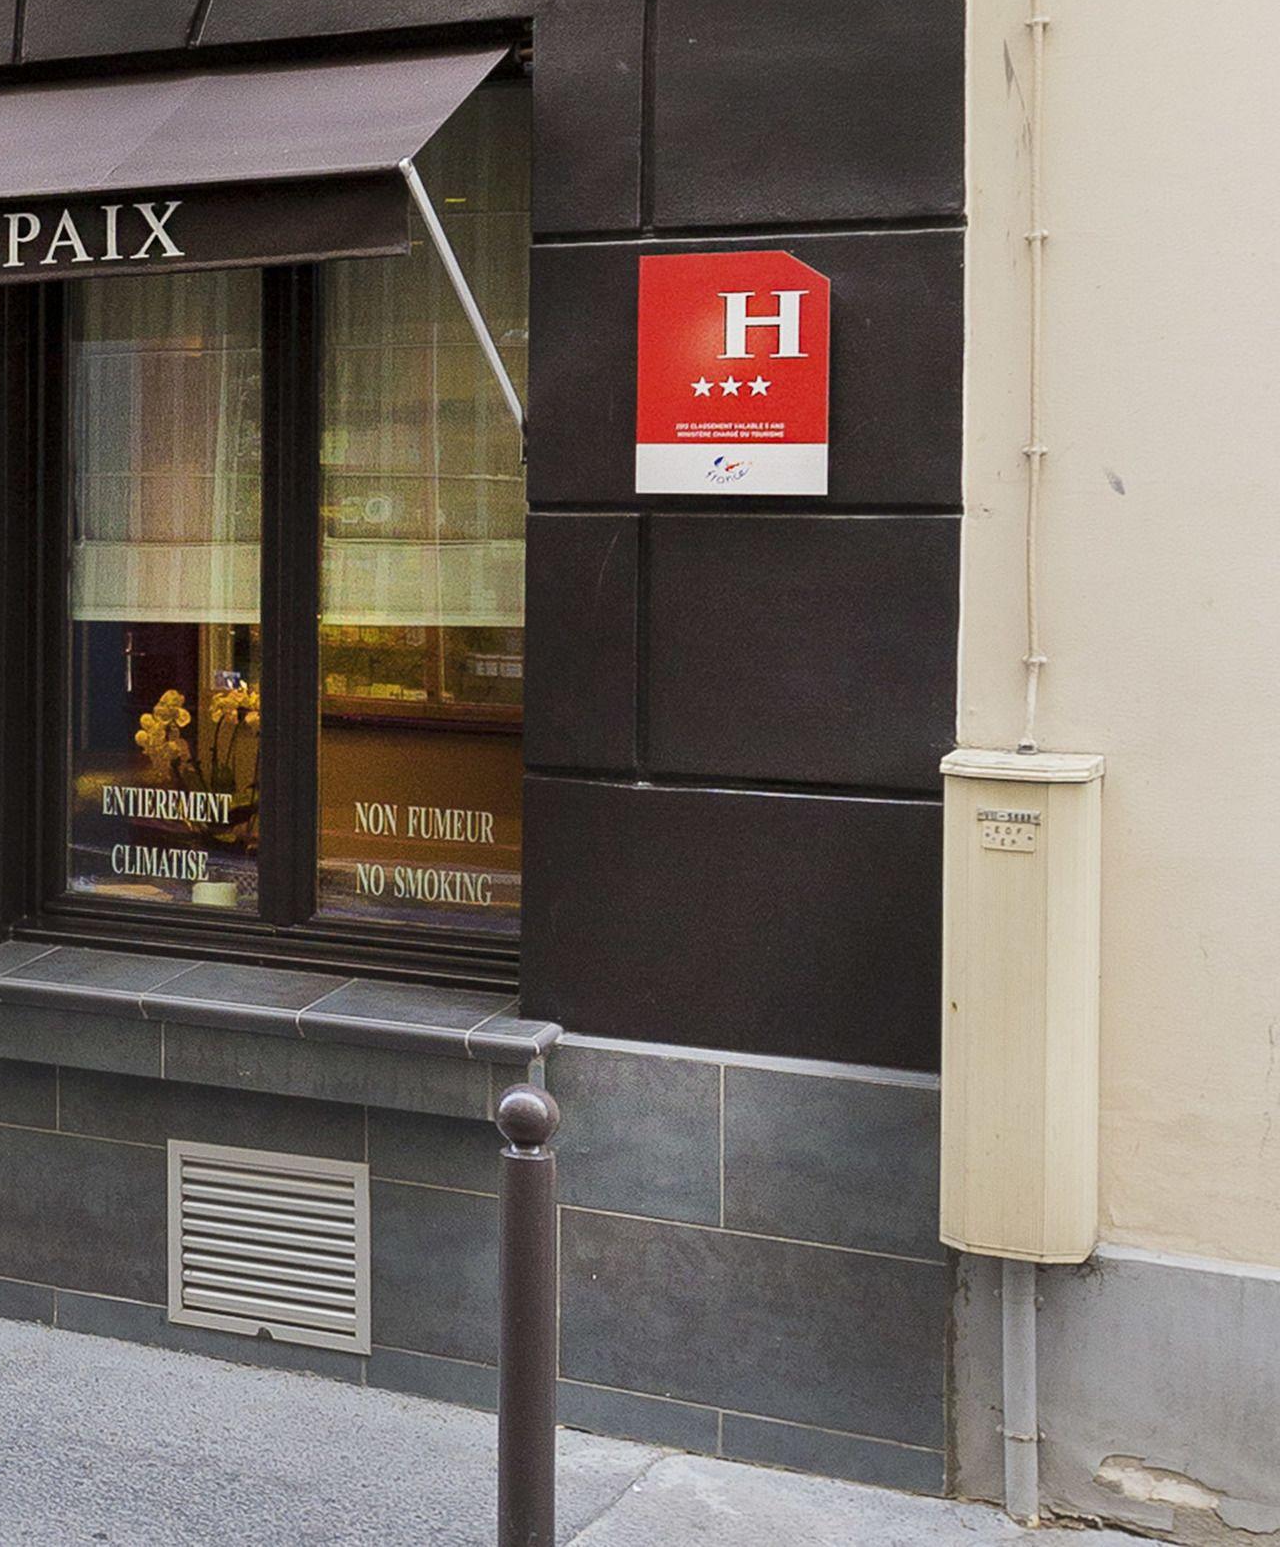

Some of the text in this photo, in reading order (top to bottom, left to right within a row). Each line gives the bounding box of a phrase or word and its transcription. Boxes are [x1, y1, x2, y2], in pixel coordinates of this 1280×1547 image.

[2, 201, 186, 268] PAIX
[716, 289, 810, 359] H
[102, 785, 233, 824] ENTIEREMENT
[355, 801, 494, 843] NON FUMEUR
[111, 844, 209, 881] CLIMATISE
[355, 863, 492, 906] NO SMOKING
